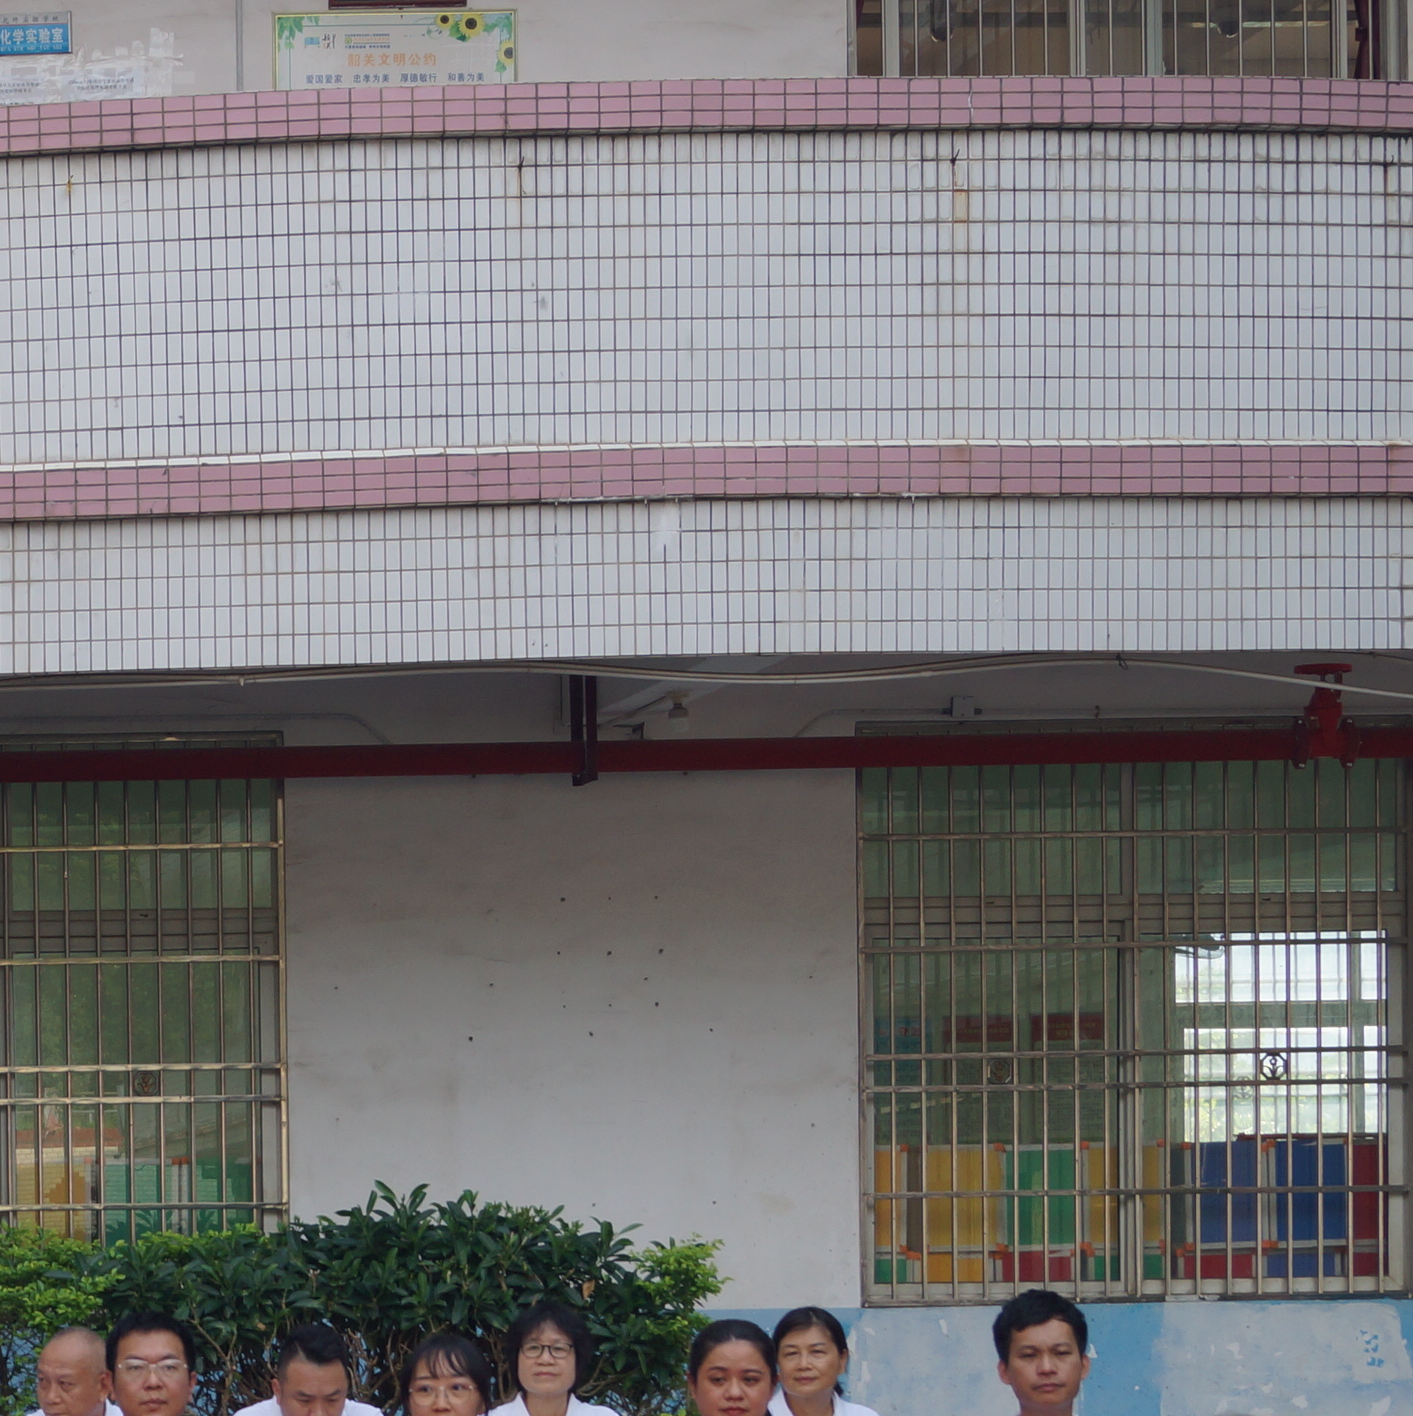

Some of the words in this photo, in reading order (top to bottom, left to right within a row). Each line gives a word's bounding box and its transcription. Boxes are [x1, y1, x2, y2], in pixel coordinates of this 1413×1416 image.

[0, 27, 64, 45] 化学实验室
[347, 53, 437, 67] 韶关文明公约
[306, 74, 343, 83] 爱国爱家
[353, 73, 390, 83] 忠孝为美
[400, 72, 437, 82] 厚德敏行
[448, 72, 485, 82] 和善为美
